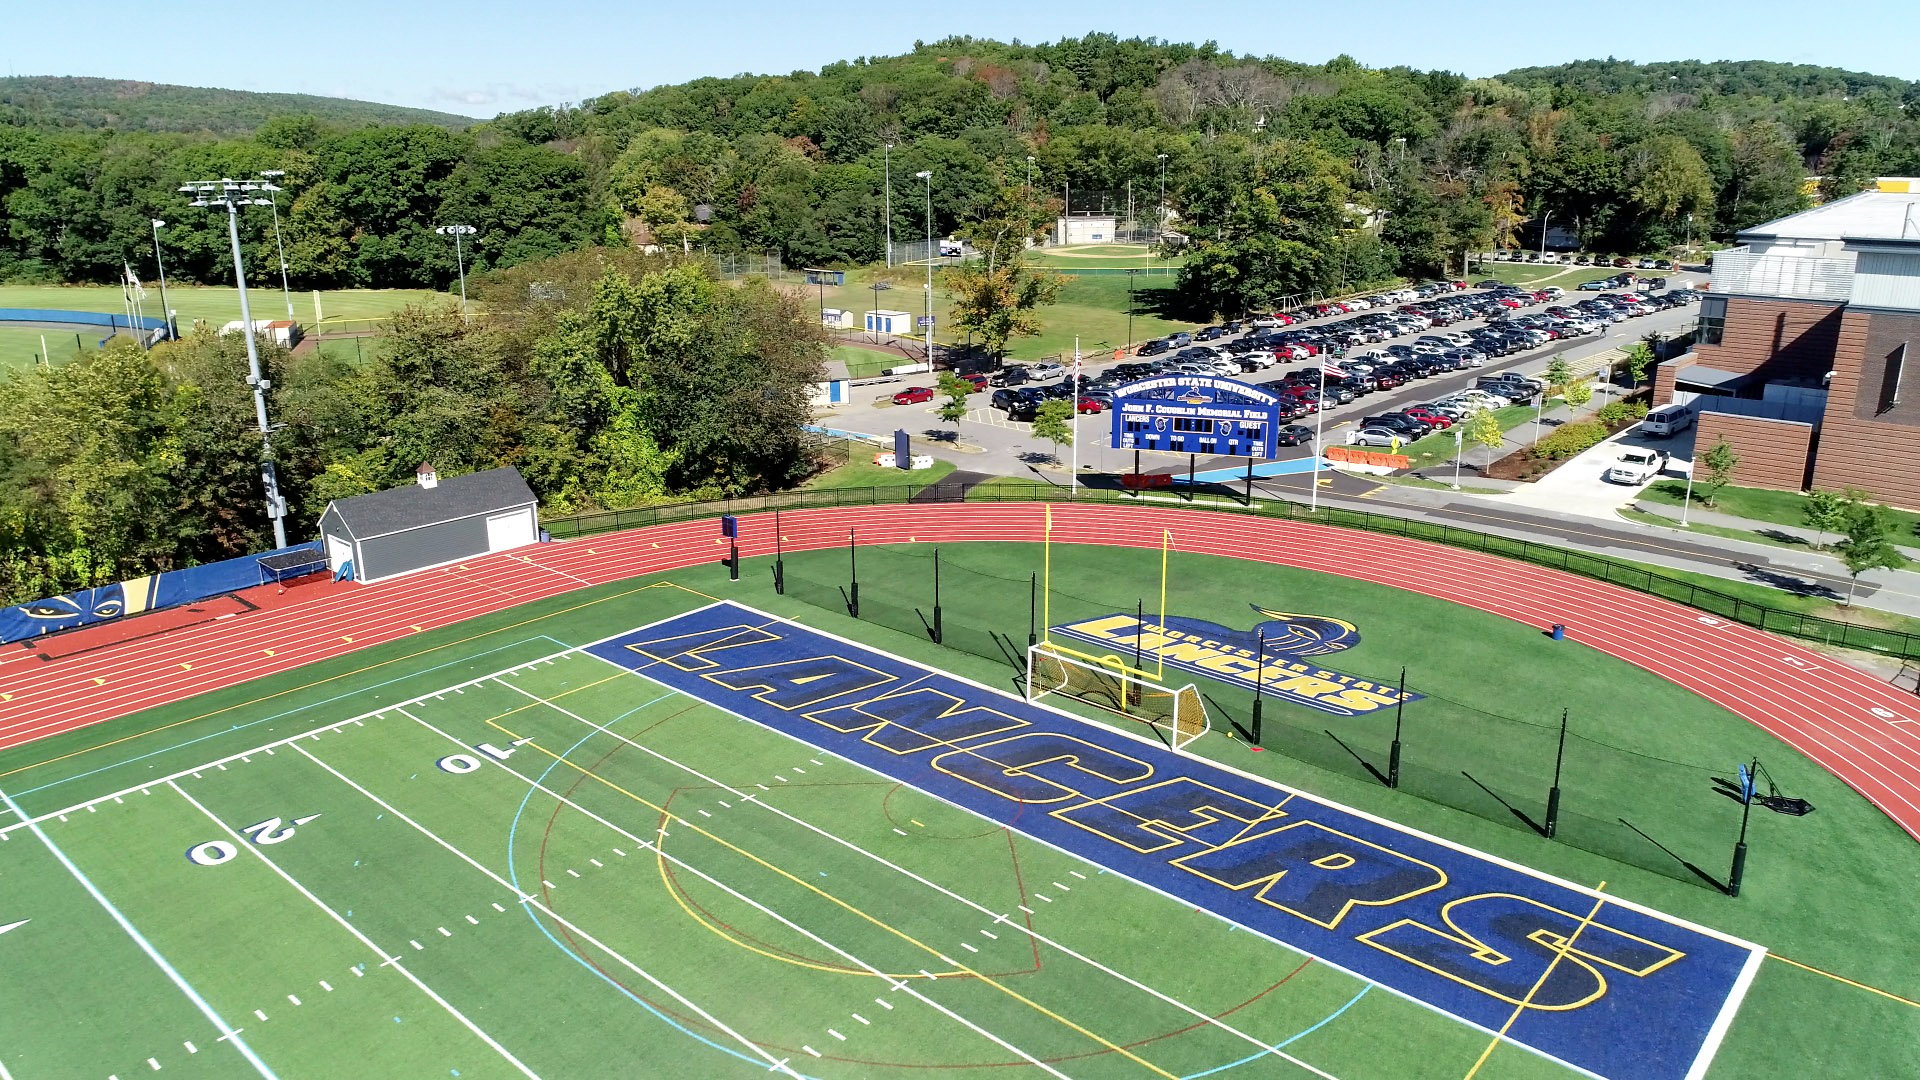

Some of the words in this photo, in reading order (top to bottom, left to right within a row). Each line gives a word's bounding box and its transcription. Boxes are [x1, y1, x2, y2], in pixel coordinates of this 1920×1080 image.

[1114, 378, 1176, 398] WORCESTER
[1178, 377, 1213, 388] STATE
[1213, 379, 1278, 406] UNIVERSITY
[1122, 403, 1144, 412] JOHN
[1145, 404, 1154, 413] F.
[1197, 407, 1242, 418] MEMORIAL
[1243, 410, 1268, 419] FIELD
[1125, 415, 1149, 423] LANCERS
[1239, 421, 1261, 429] GUEST
[1145, 433, 1160, 441] DOWN
[1228, 438, 1239, 446] QTR
[1065, 614, 1400, 711] LANCERS
[1142, 624, 1309, 673] WORCESTER
[1313, 670, 1413, 701] STATE
[435, 743, 517, 774] 10
[624, 624, 1687, 1011] LANCERS
[185, 816, 296, 867] 20
